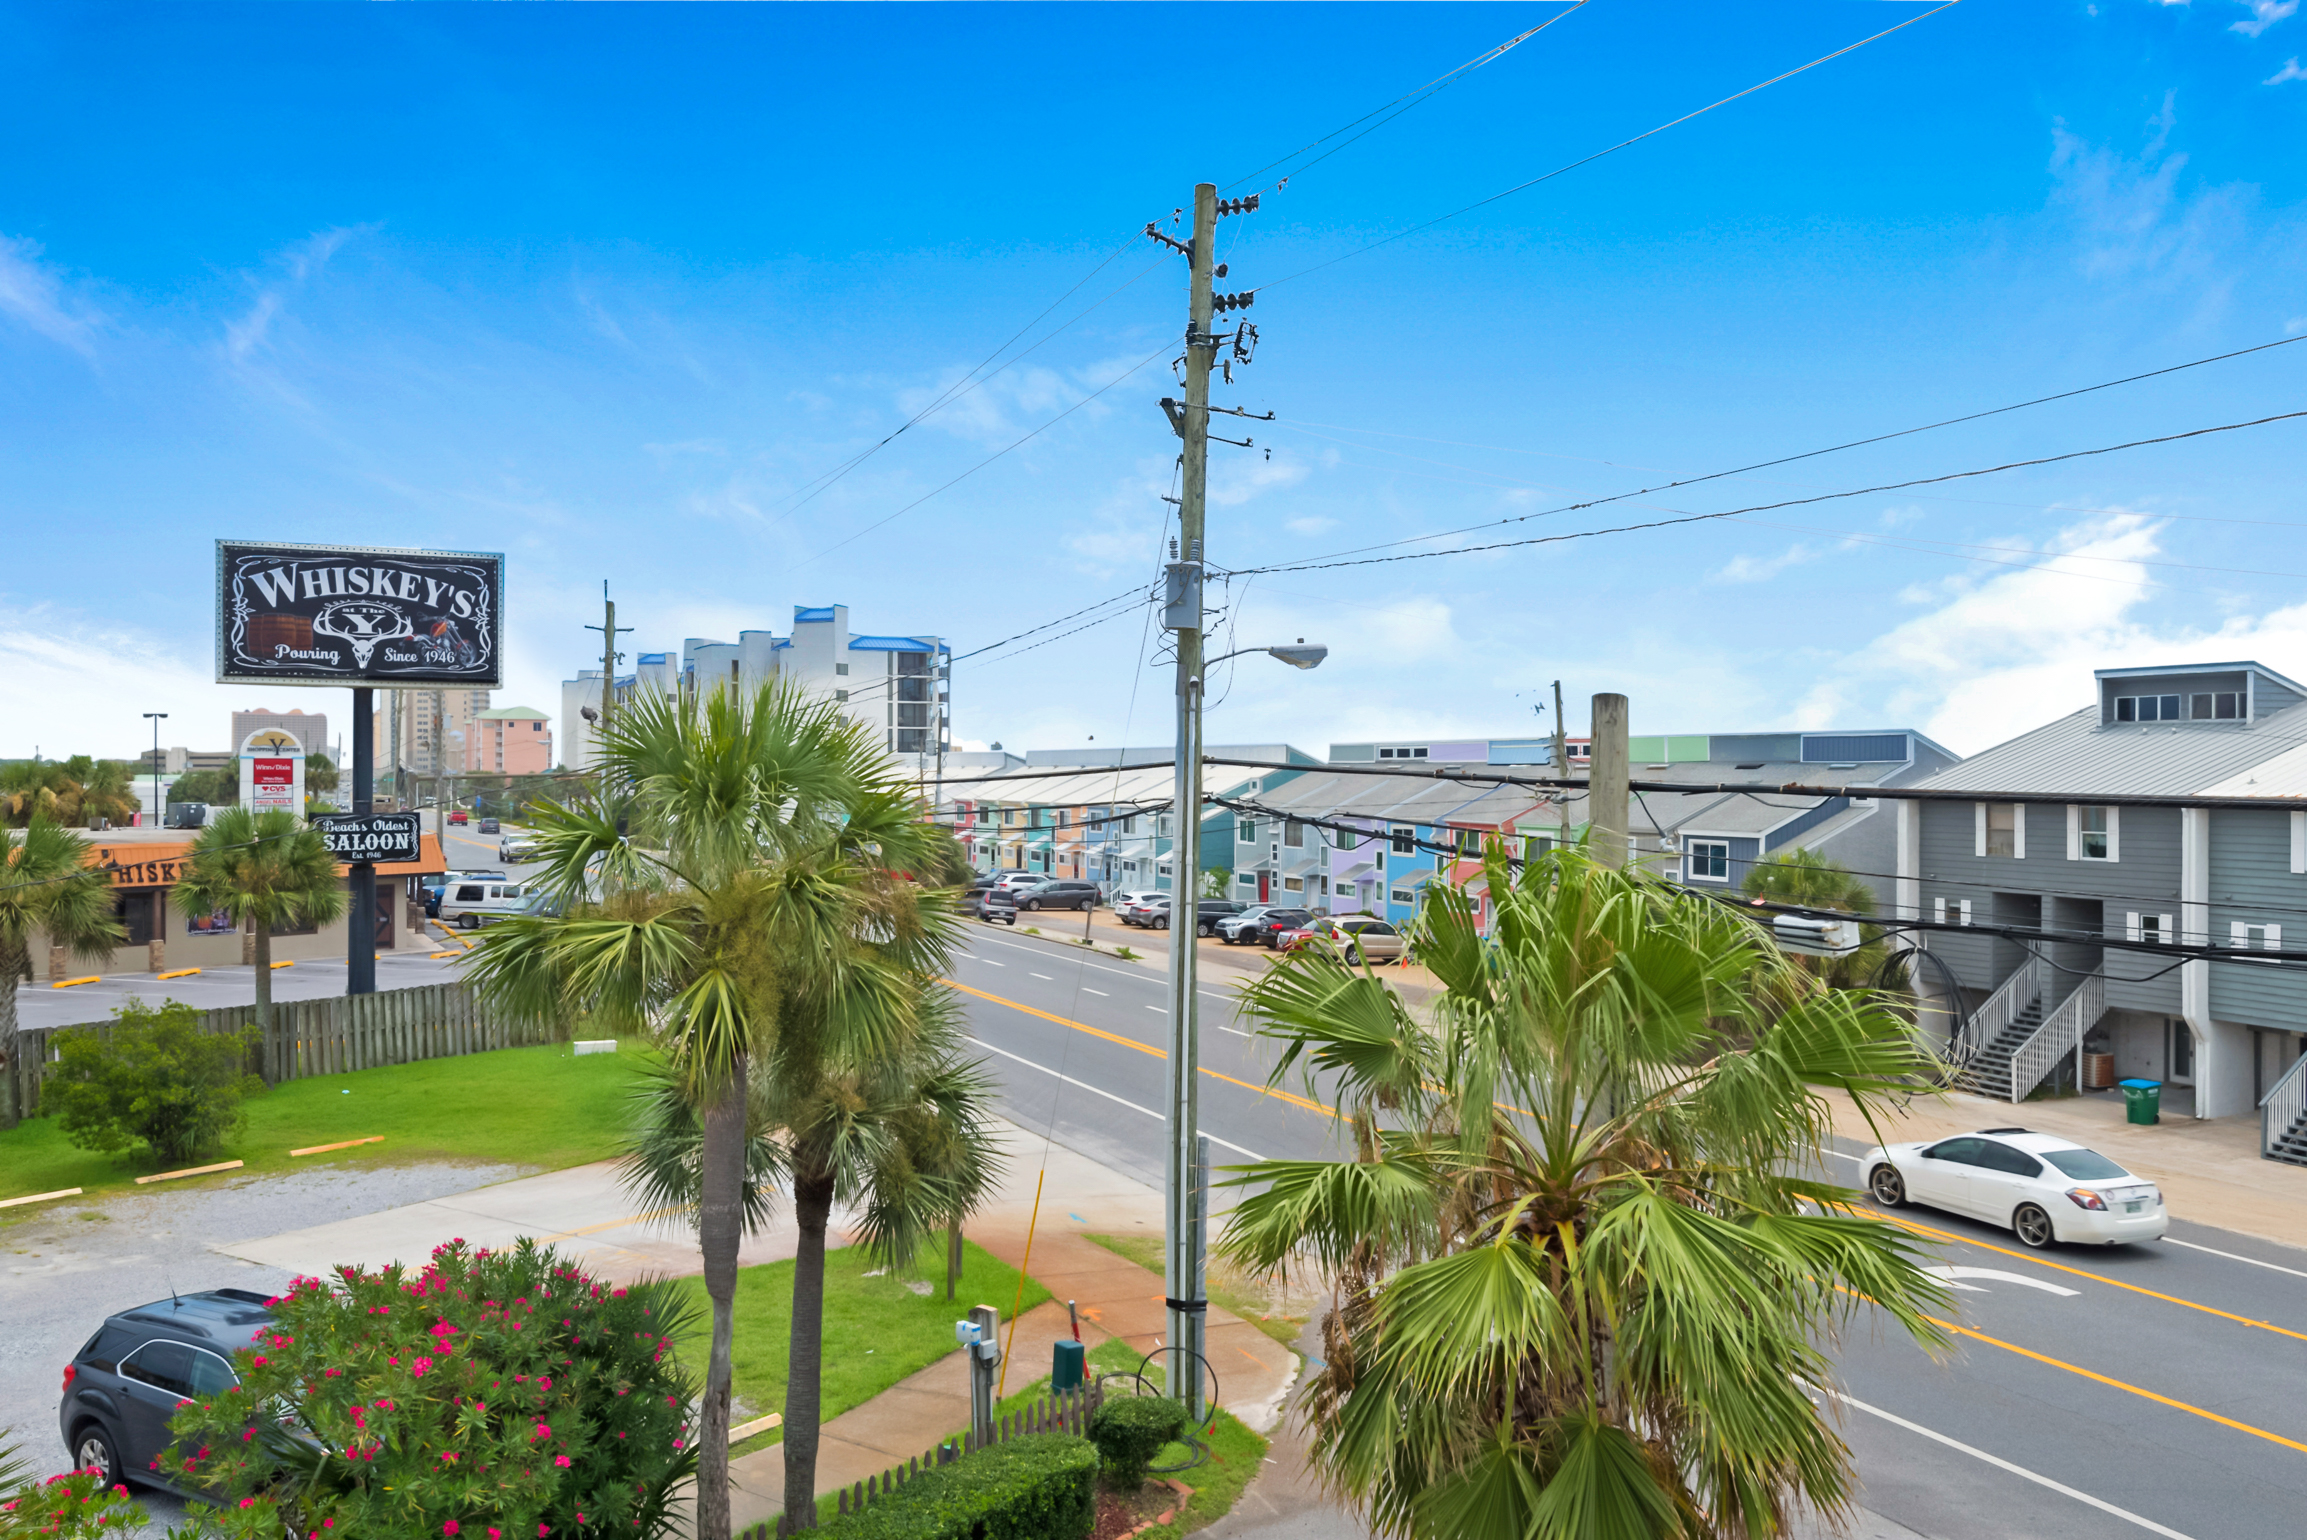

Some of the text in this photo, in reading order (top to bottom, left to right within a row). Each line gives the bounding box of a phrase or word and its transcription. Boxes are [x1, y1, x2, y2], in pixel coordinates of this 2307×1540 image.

[248, 563, 476, 619] WHISKEY'S
[342, 614, 386, 634] Y
[275, 643, 455, 666] Pouring Since 1946
[269, 738, 287, 756] Y
[372, 819, 409, 831] Oldest
[323, 833, 409, 851] SALOON
[366, 851, 382, 859] 1946
